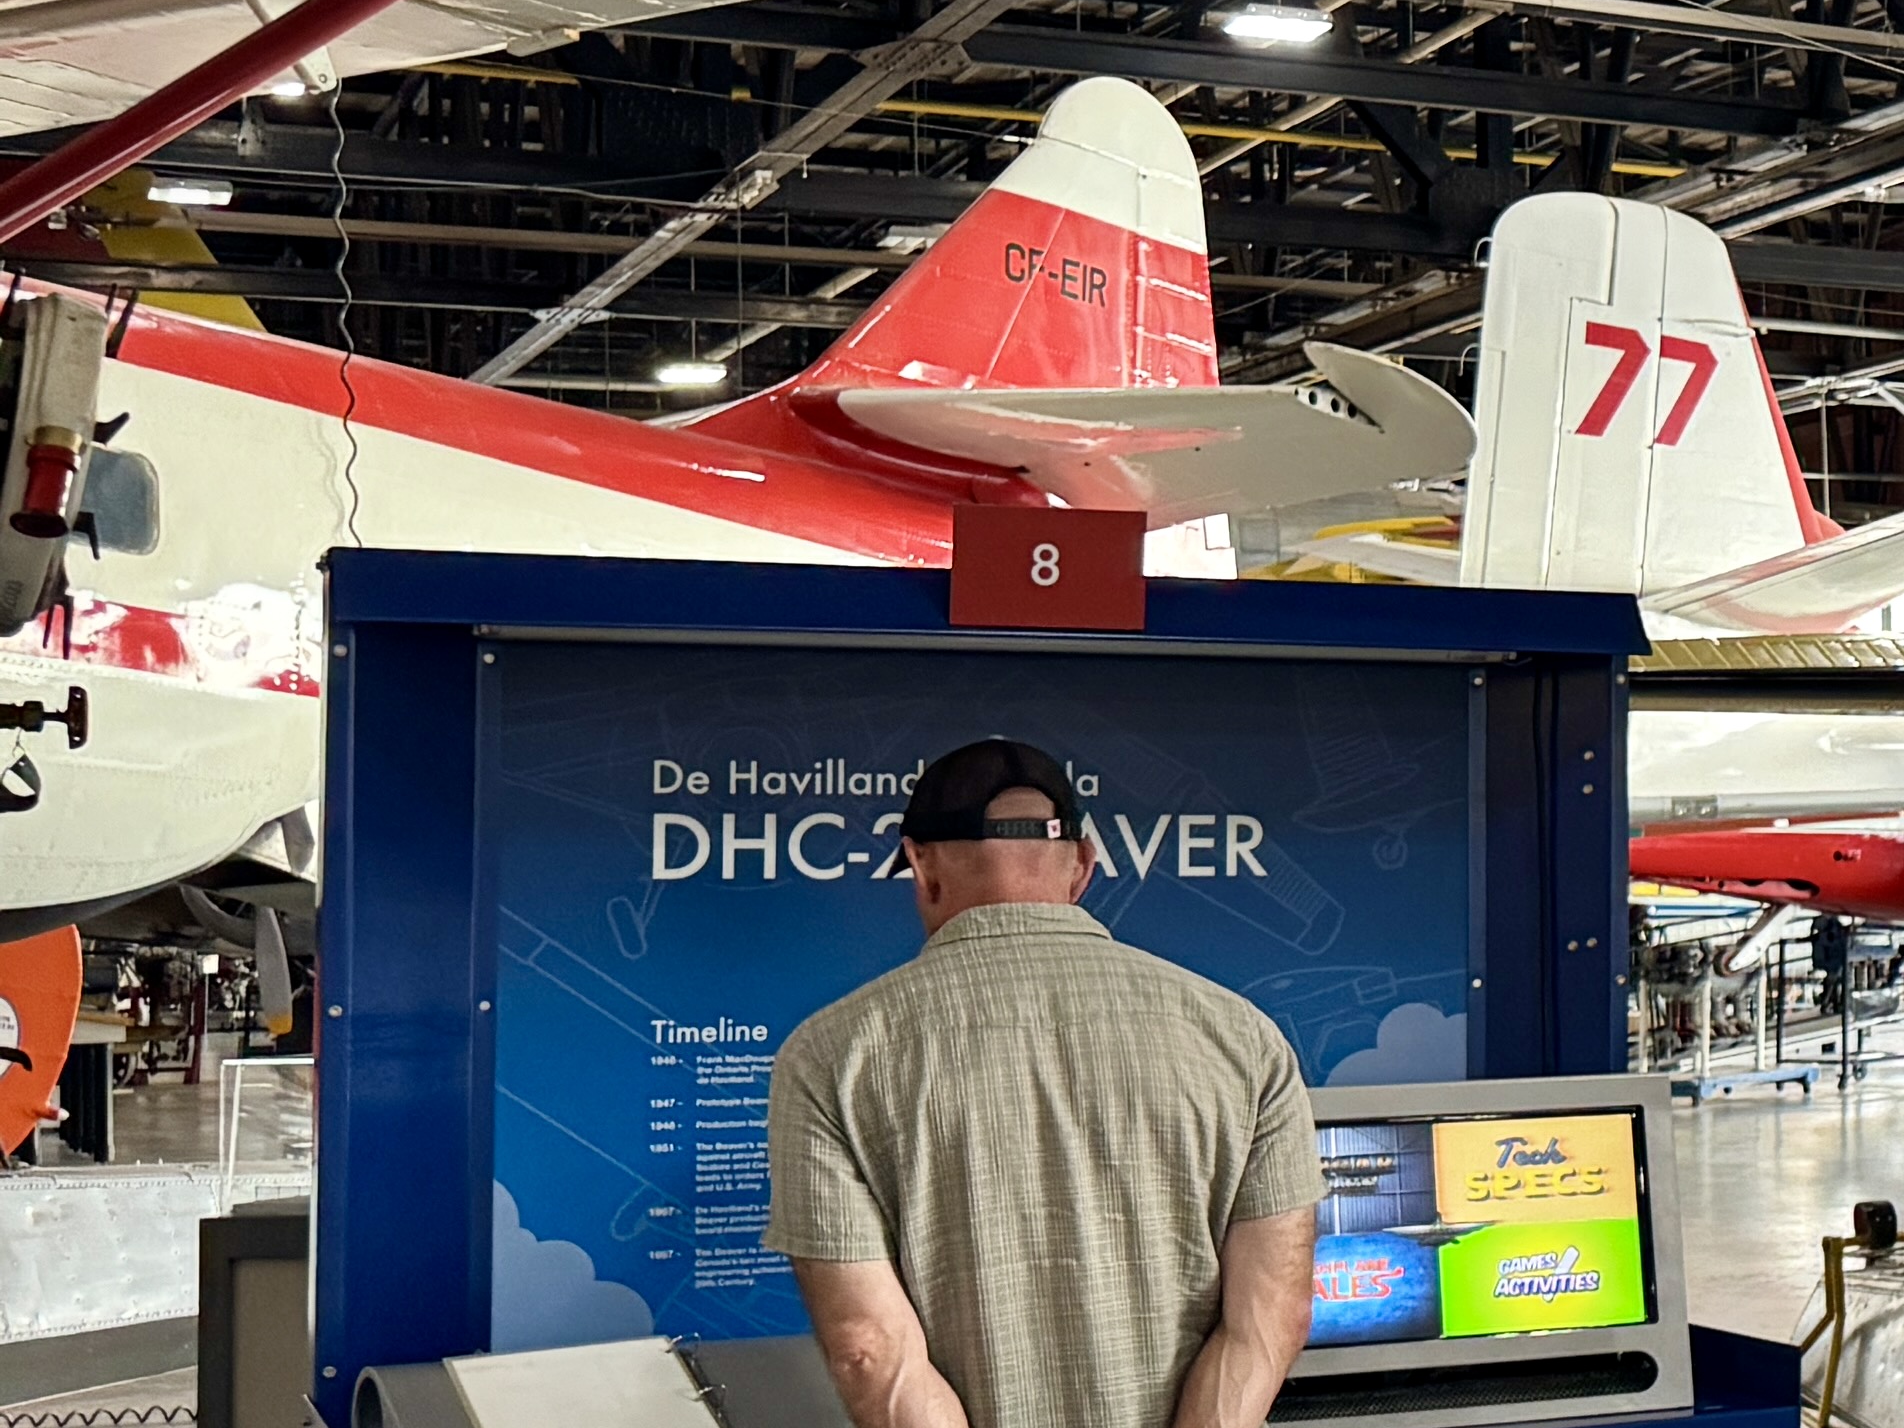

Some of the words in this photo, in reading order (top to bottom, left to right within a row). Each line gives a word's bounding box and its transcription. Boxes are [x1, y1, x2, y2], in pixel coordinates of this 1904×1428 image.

[1005, 242, 1107, 308] CF-EIR
[1574, 320, 1719, 447] 77
[1031, 543, 1060, 587] 8
[653, 759, 710, 795] De
[729, 758, 925, 795] Havilland
[652, 812, 914, 880] DHC-2
[1080, 811, 1269, 881] AVER
[651, 1016, 769, 1044] Timeline
[1495, 1136, 1567, 1169] Tech
[1465, 1168, 1607, 1202] SPECS
[1498, 1252, 1559, 1276] GAMES
[1313, 1266, 1405, 1303] ALES
[1494, 1269, 1600, 1299] ACTIVITIES
